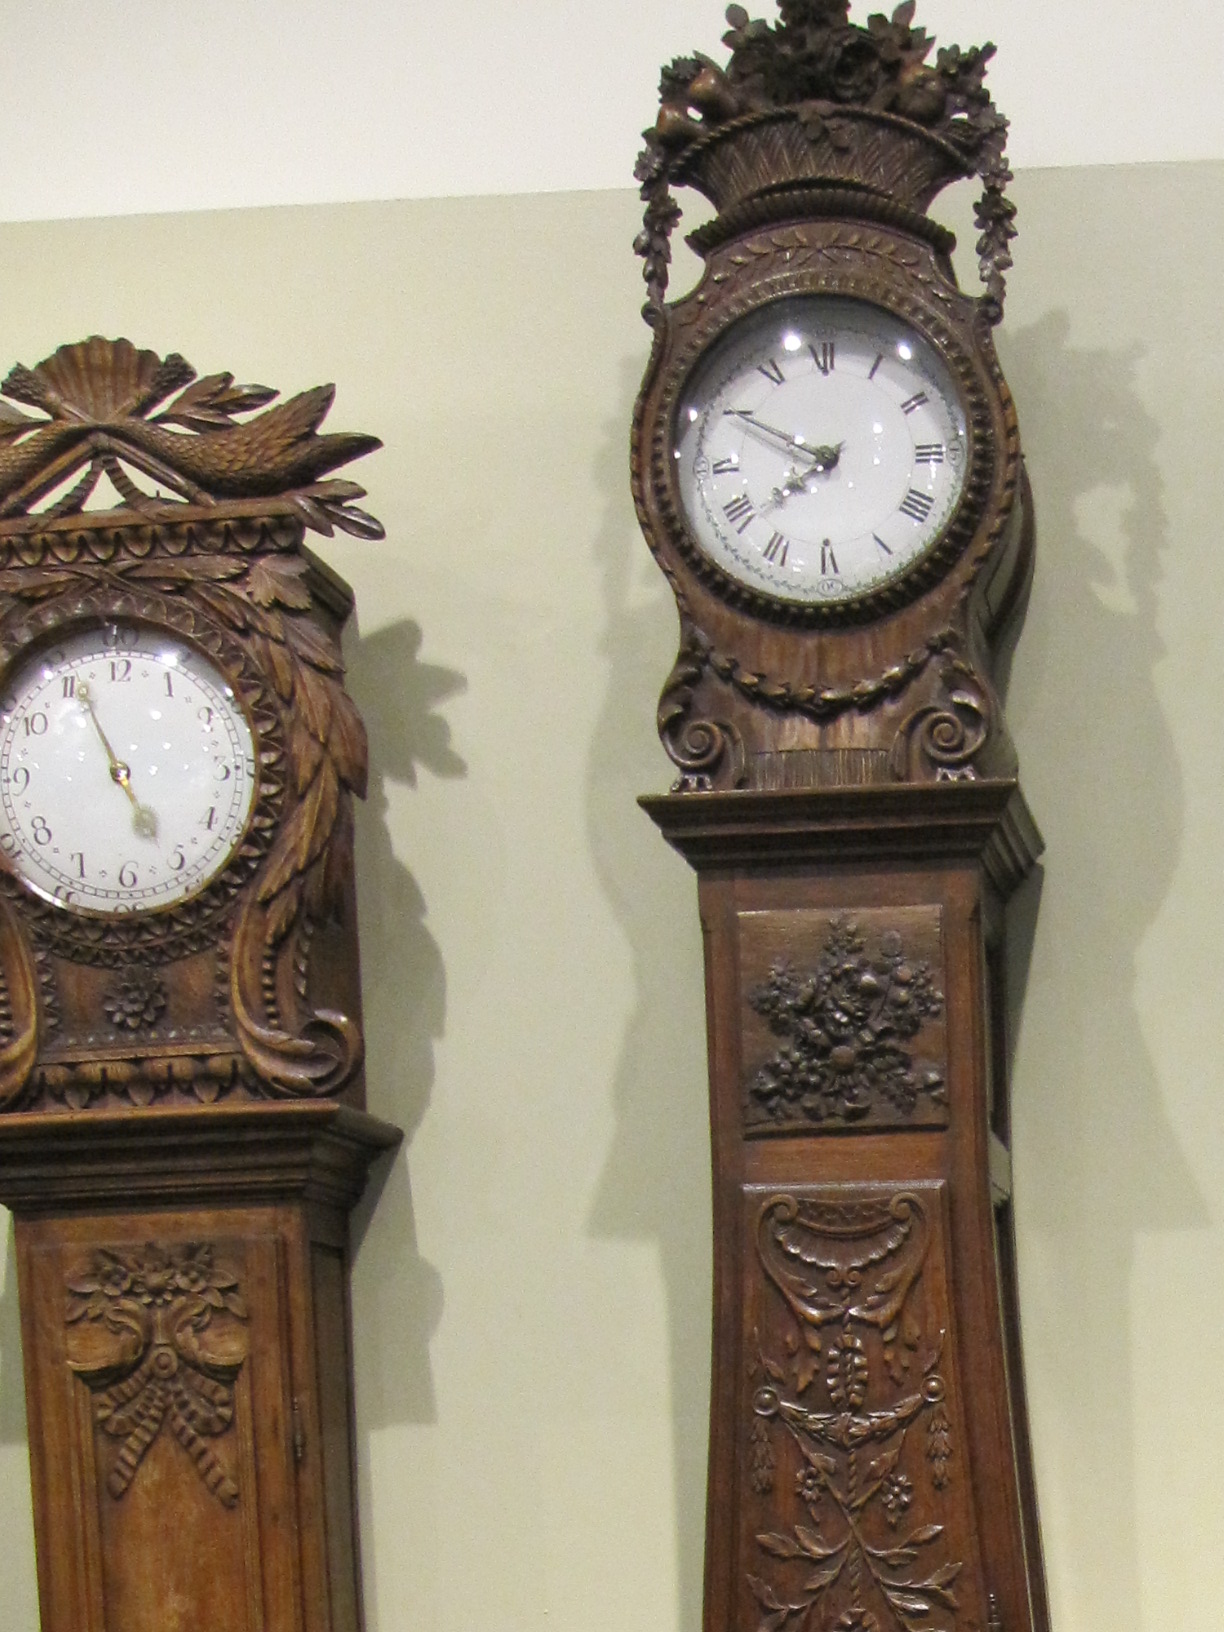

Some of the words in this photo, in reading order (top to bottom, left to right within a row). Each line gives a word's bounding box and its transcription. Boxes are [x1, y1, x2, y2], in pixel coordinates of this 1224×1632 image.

[109, 659, 132, 682] 12
[62, 675, 76, 698] 11
[163, 671, 174, 698] 1
[24, 711, 48, 737] 10
[12, 767, 30, 796] 9
[31, 815, 52, 845] 8
[198, 806, 218, 831] 4
[166, 844, 186, 870] 5
[118, 861, 138, 888] 6
